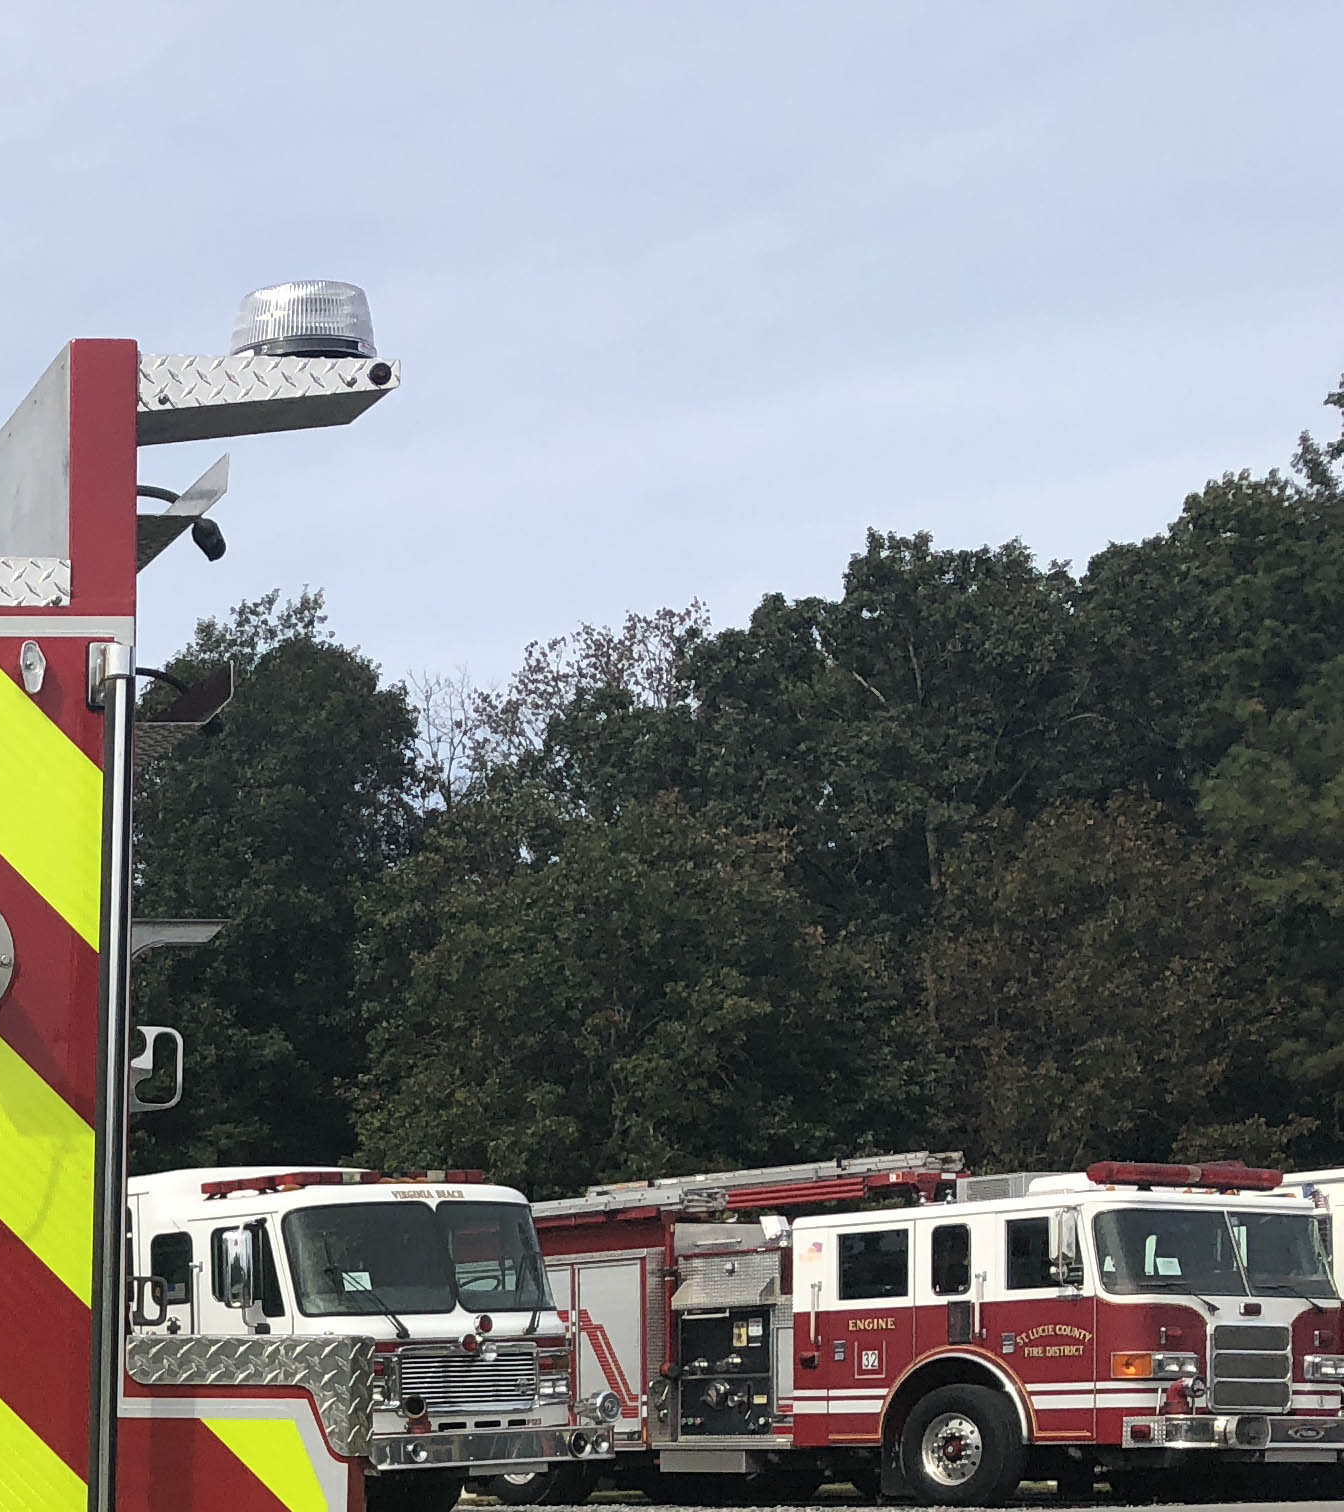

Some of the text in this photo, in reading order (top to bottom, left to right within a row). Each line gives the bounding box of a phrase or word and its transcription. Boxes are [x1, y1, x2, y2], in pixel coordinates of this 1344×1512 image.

[391, 1190, 465, 1199] VIRGINIA BEACH
[848, 1317, 896, 1331] ENGINE
[1016, 1324, 1093, 1346] ST LUCIE COUNTY
[1024, 1346, 1084, 1357] FIRE DISTRICT
[863, 1351, 878, 1368] 32
